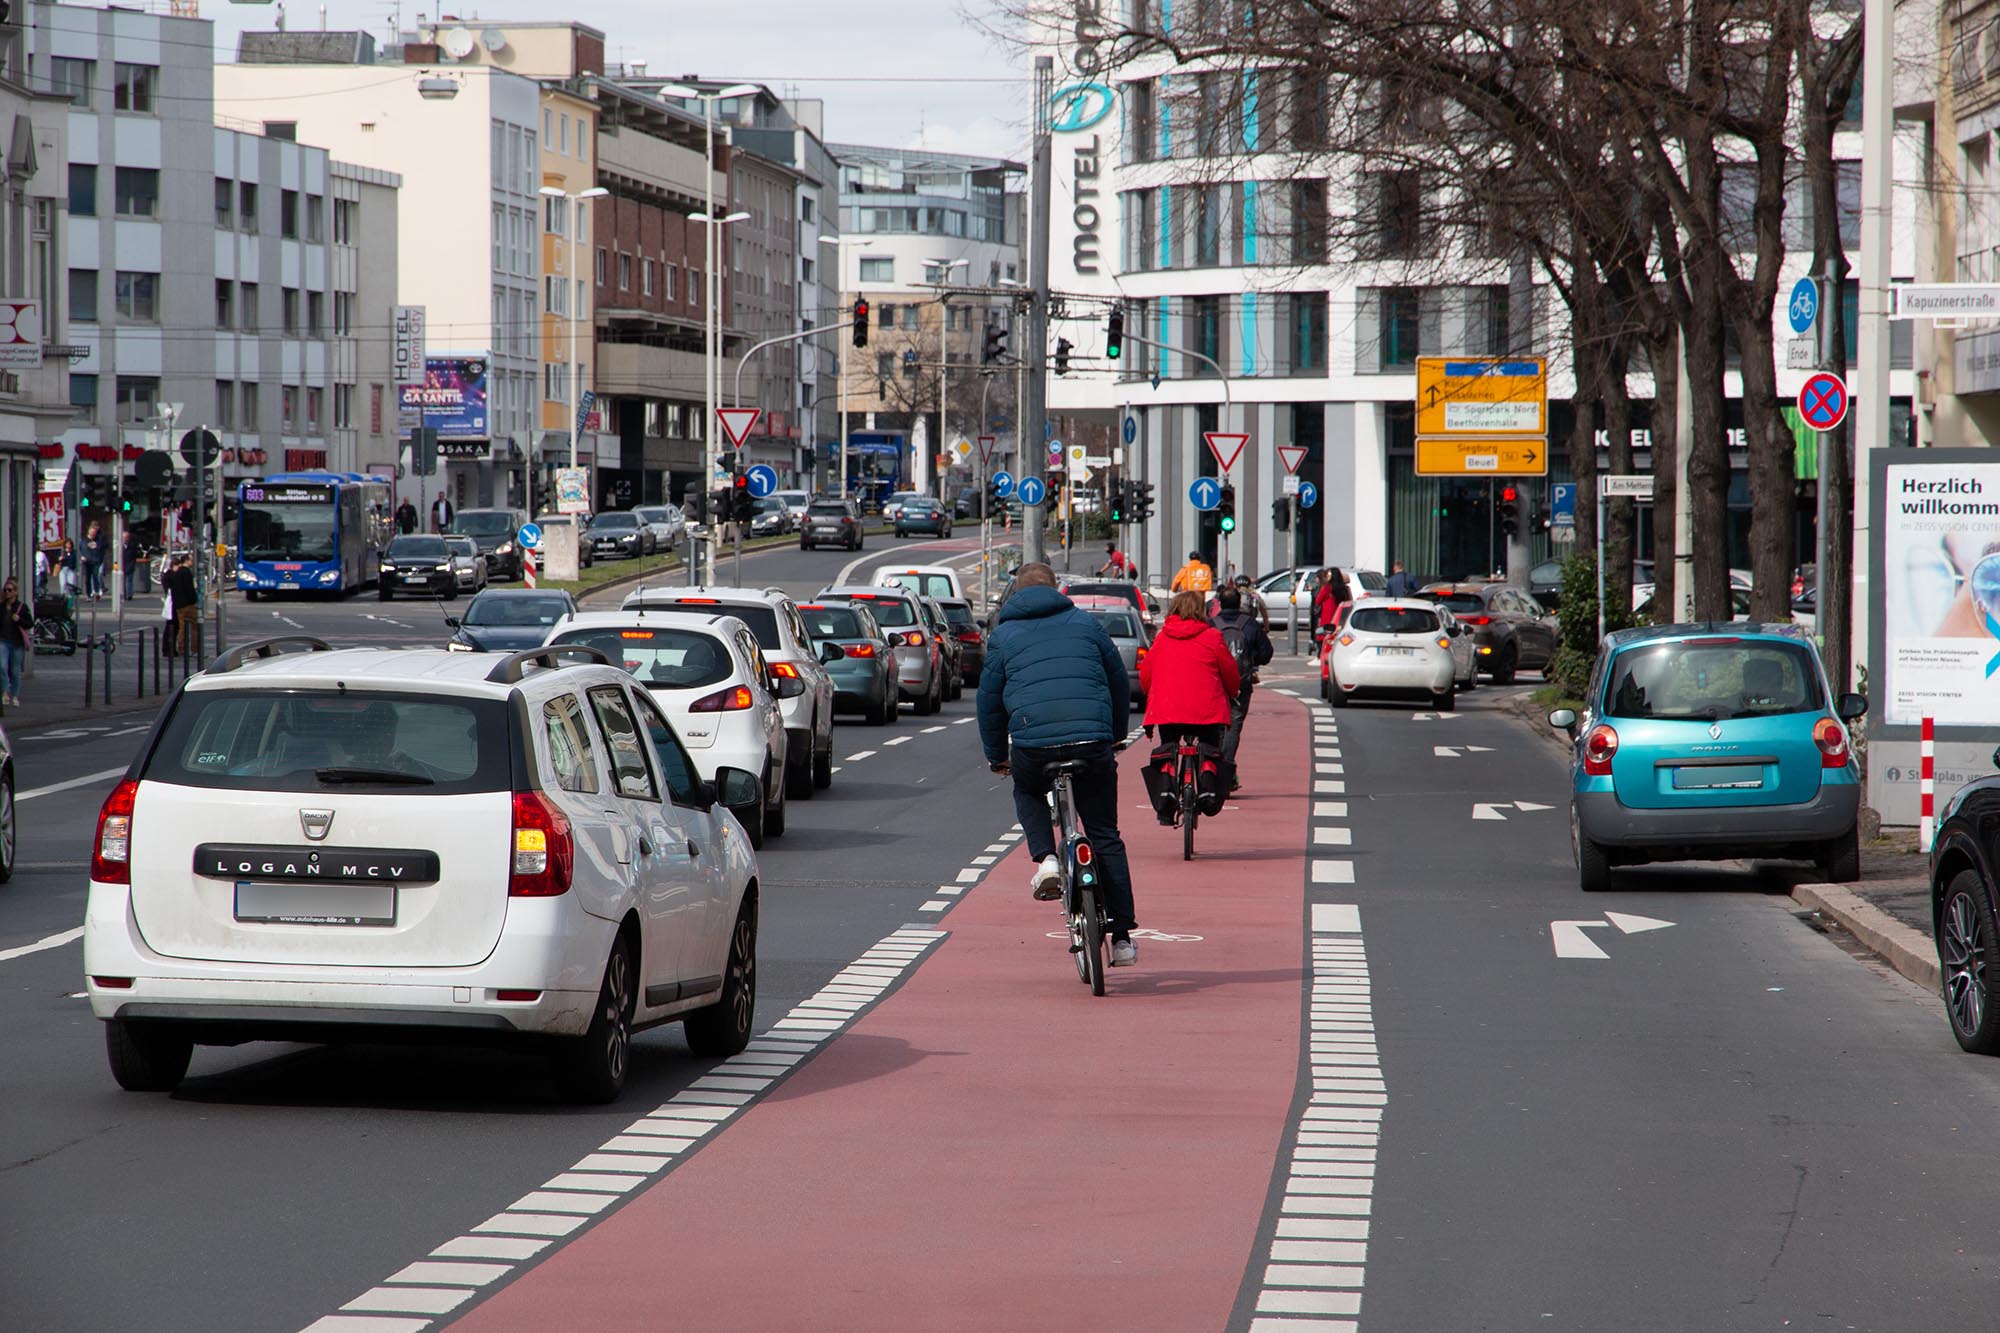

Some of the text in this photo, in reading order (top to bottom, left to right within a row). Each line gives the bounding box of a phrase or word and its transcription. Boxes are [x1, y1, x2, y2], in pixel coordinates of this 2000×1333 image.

[1907, 294, 1996, 310] Kapuzinerstraße
[395, 309, 408, 381] HOTEL
[411, 338, 421, 369] Bonn
[1790, 347, 1809, 360] Ende
[1465, 403, 1538, 415] Sportpark Nord
[1447, 419, 1518, 428] Beethovenhalle
[1457, 443, 1498, 454] Siegburg
[1467, 459, 1495, 467] Beuel
[1902, 478, 1982, 494] Herzlich
[1554, 486, 1567, 504] P
[38, 497, 62, 512] ALE
[1901, 499, 2000, 515] willkomm
[217, 861, 404, 876] LOGAN MCV
